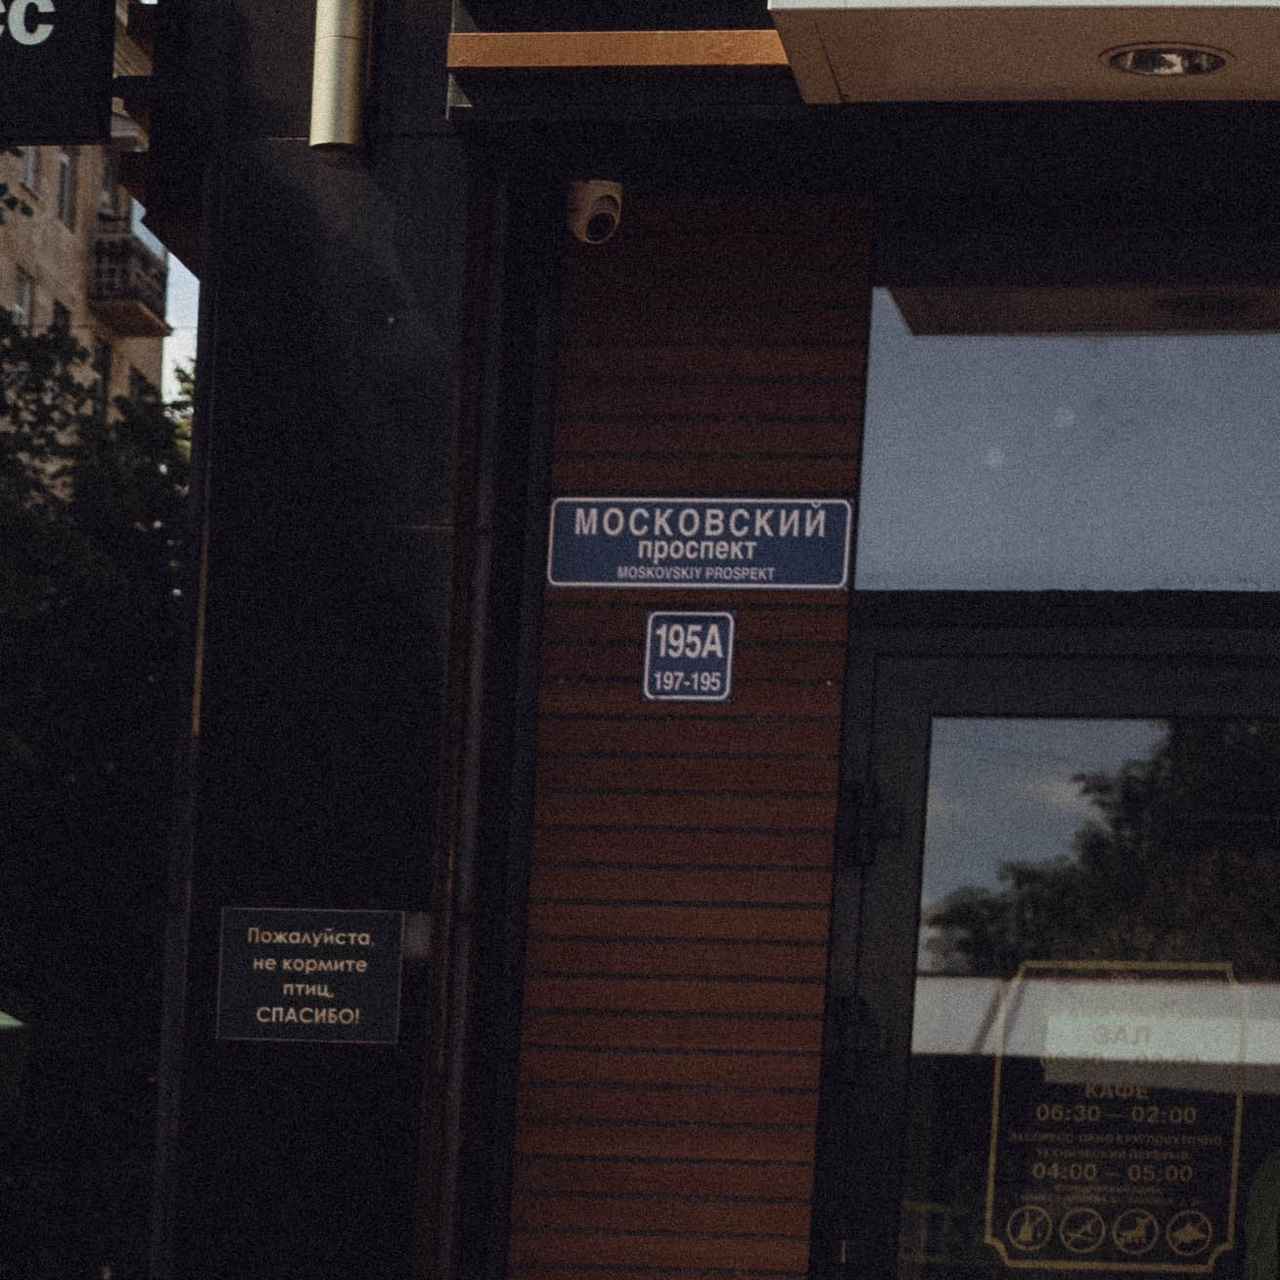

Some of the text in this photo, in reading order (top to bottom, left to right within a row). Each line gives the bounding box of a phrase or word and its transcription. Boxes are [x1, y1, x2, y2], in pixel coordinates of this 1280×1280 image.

[574, 500, 826, 537] МОСКОВСКИЙ
[638, 540, 757, 564] проспект
[617, 566, 775, 580] MOSKOVSKIY PROSPEKT
[656, 624, 724, 659] 195А
[654, 671, 721, 691] 197-195
[253, 958, 368, 974] не кормите
[256, 1007, 360, 1024] СПАСИБО!
[1036, 1104, 1102, 1122] 06:30
[1131, 1106, 1197, 1124] 02:00
[1031, 1162, 1098, 1181] 04:00
